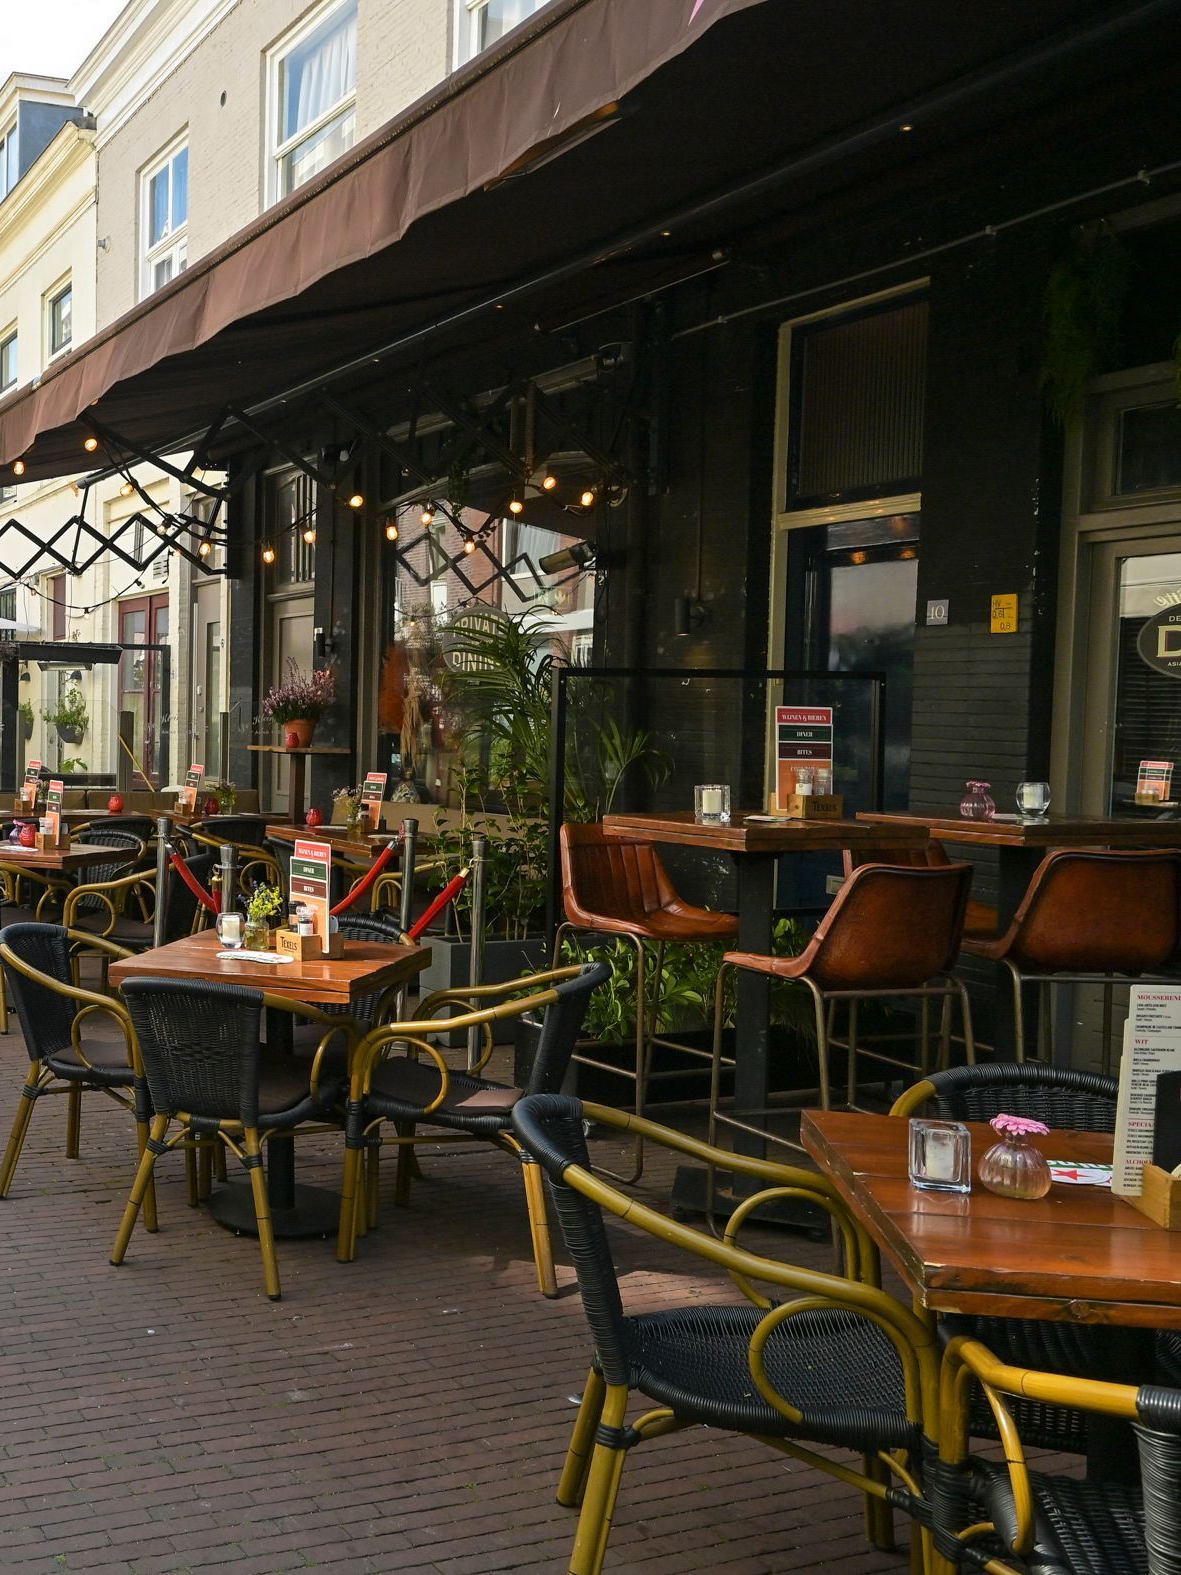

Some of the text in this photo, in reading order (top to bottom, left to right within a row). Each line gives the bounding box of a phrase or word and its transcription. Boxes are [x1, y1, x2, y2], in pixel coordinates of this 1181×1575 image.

[930, 605, 944, 620] 10
[1000, 622, 1010, 631] 0,8
[280, 936, 297, 950] TEXELS
